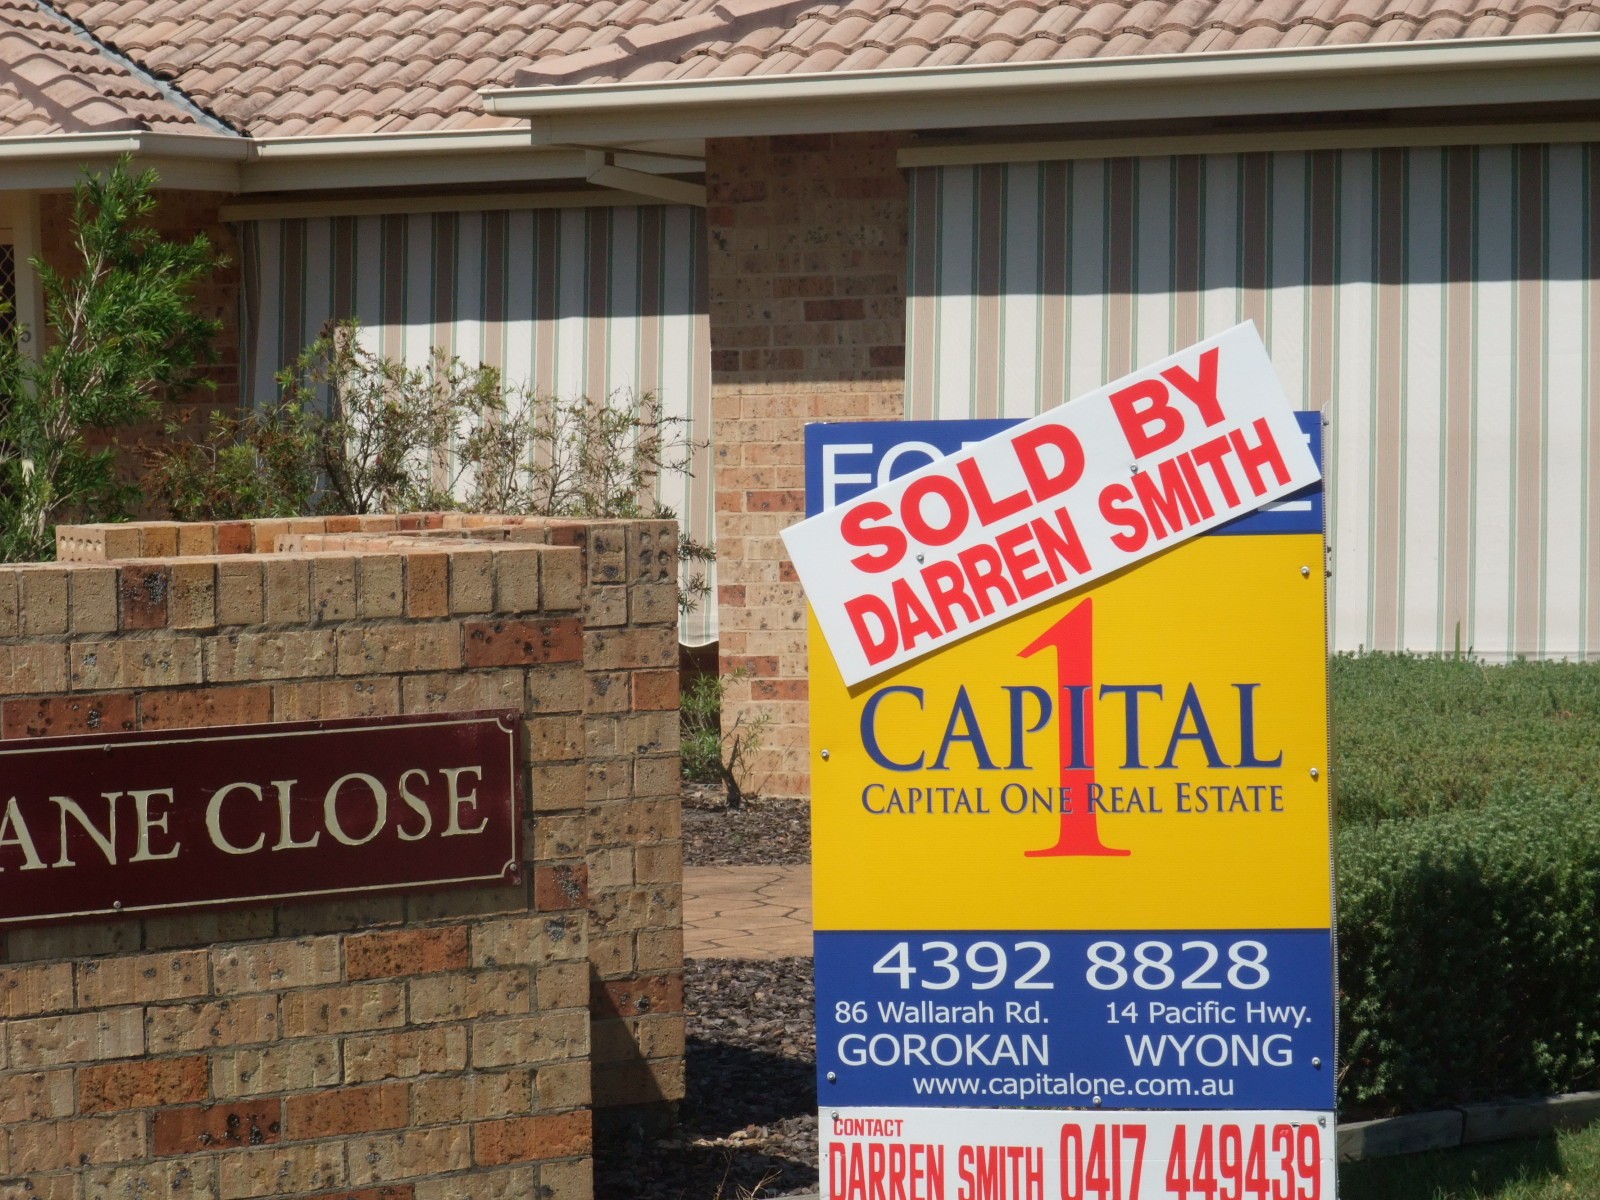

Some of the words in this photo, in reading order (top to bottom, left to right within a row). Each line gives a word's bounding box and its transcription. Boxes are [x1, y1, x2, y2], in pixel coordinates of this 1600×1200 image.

[840, 423, 1085, 573] SOLD
[1108, 346, 1226, 460] BY
[843, 506, 1092, 666] DARREN
[1098, 417, 1292, 553] SMITH
[860, 681, 1283, 772] CAPITAL
[205, 765, 489, 855] CLOSE
[861, 783, 990, 815] CAPITAL
[1000, 783, 1073, 815] ONE
[1086, 783, 1162, 814] REAL
[1175, 782, 1284, 813] ESTATE
[872, 941, 1055, 991] 4392
[1085, 940, 1270, 991] 8828
[834, 1001, 868, 1024] 86
[877, 1001, 995, 1024] Wallarah
[1005, 1001, 1050, 1024] Rd.
[1106, 1002, 1138, 1024] 14
[1149, 1001, 1236, 1025] Pacific
[1246, 1001, 1312, 1029] Hwy.
[837, 1033, 1050, 1067] GOROKAN
[1124, 1033, 1294, 1067] WYONG
[912, 1072, 1235, 1099] www.capitalone.com.au
[833, 1118, 904, 1137] CONTACT
[828, 1142, 944, 1200] DARREN
[957, 1145, 1044, 1200] SMITH
[1060, 1123, 1147, 1200] 0417
[1165, 1123, 1322, 1200] 449439
